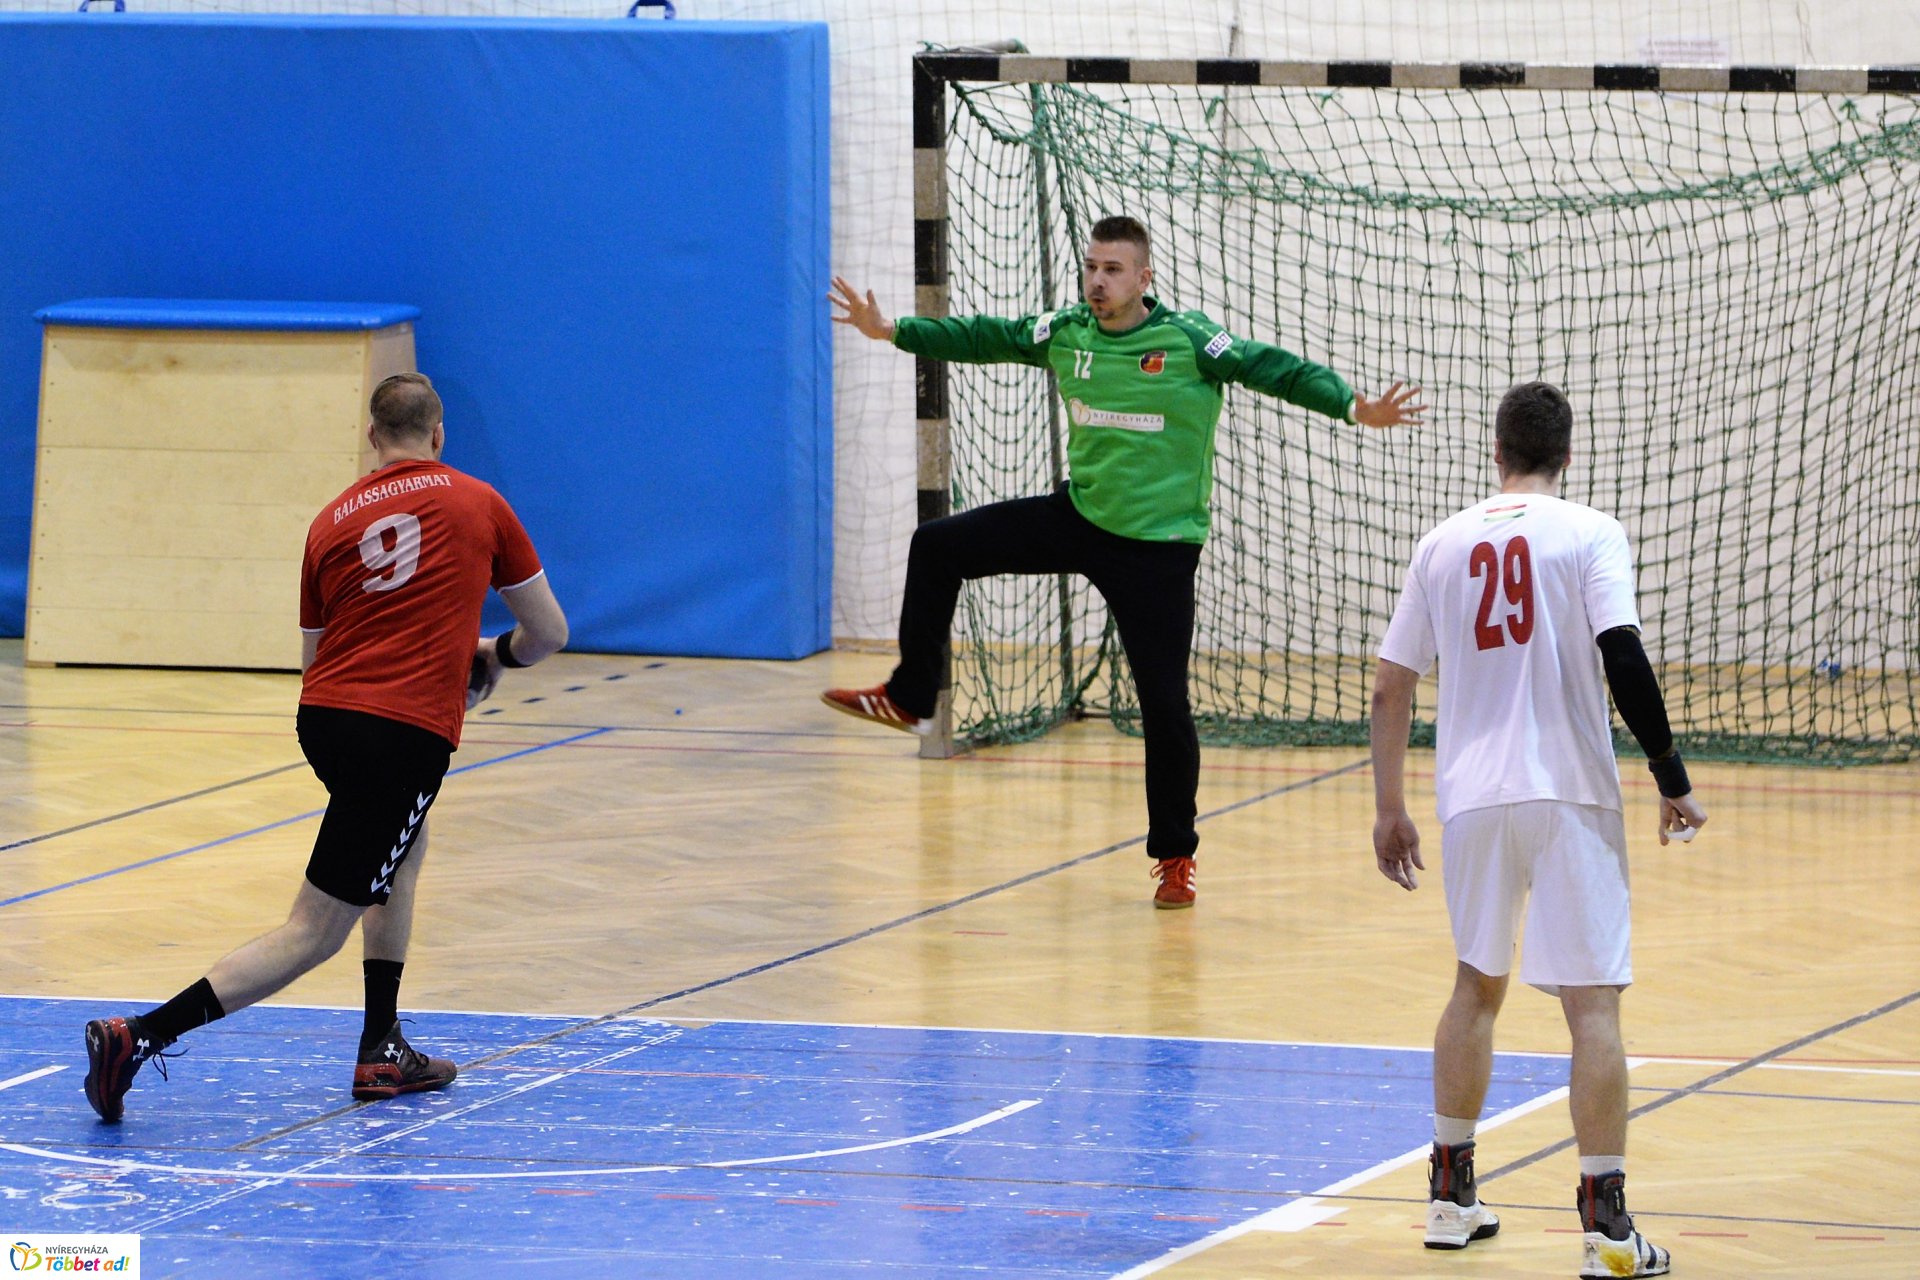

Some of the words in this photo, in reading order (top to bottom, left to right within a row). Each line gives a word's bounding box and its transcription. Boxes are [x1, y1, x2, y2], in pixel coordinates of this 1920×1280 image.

[1073, 349, 1094, 380] 12
[1093, 411, 1162, 424] NYÍREGYHÁZA
[333, 474, 453, 526] BALASSAGYARMAT
[357, 512, 422, 594] 9
[1469, 535, 1535, 651] 29
